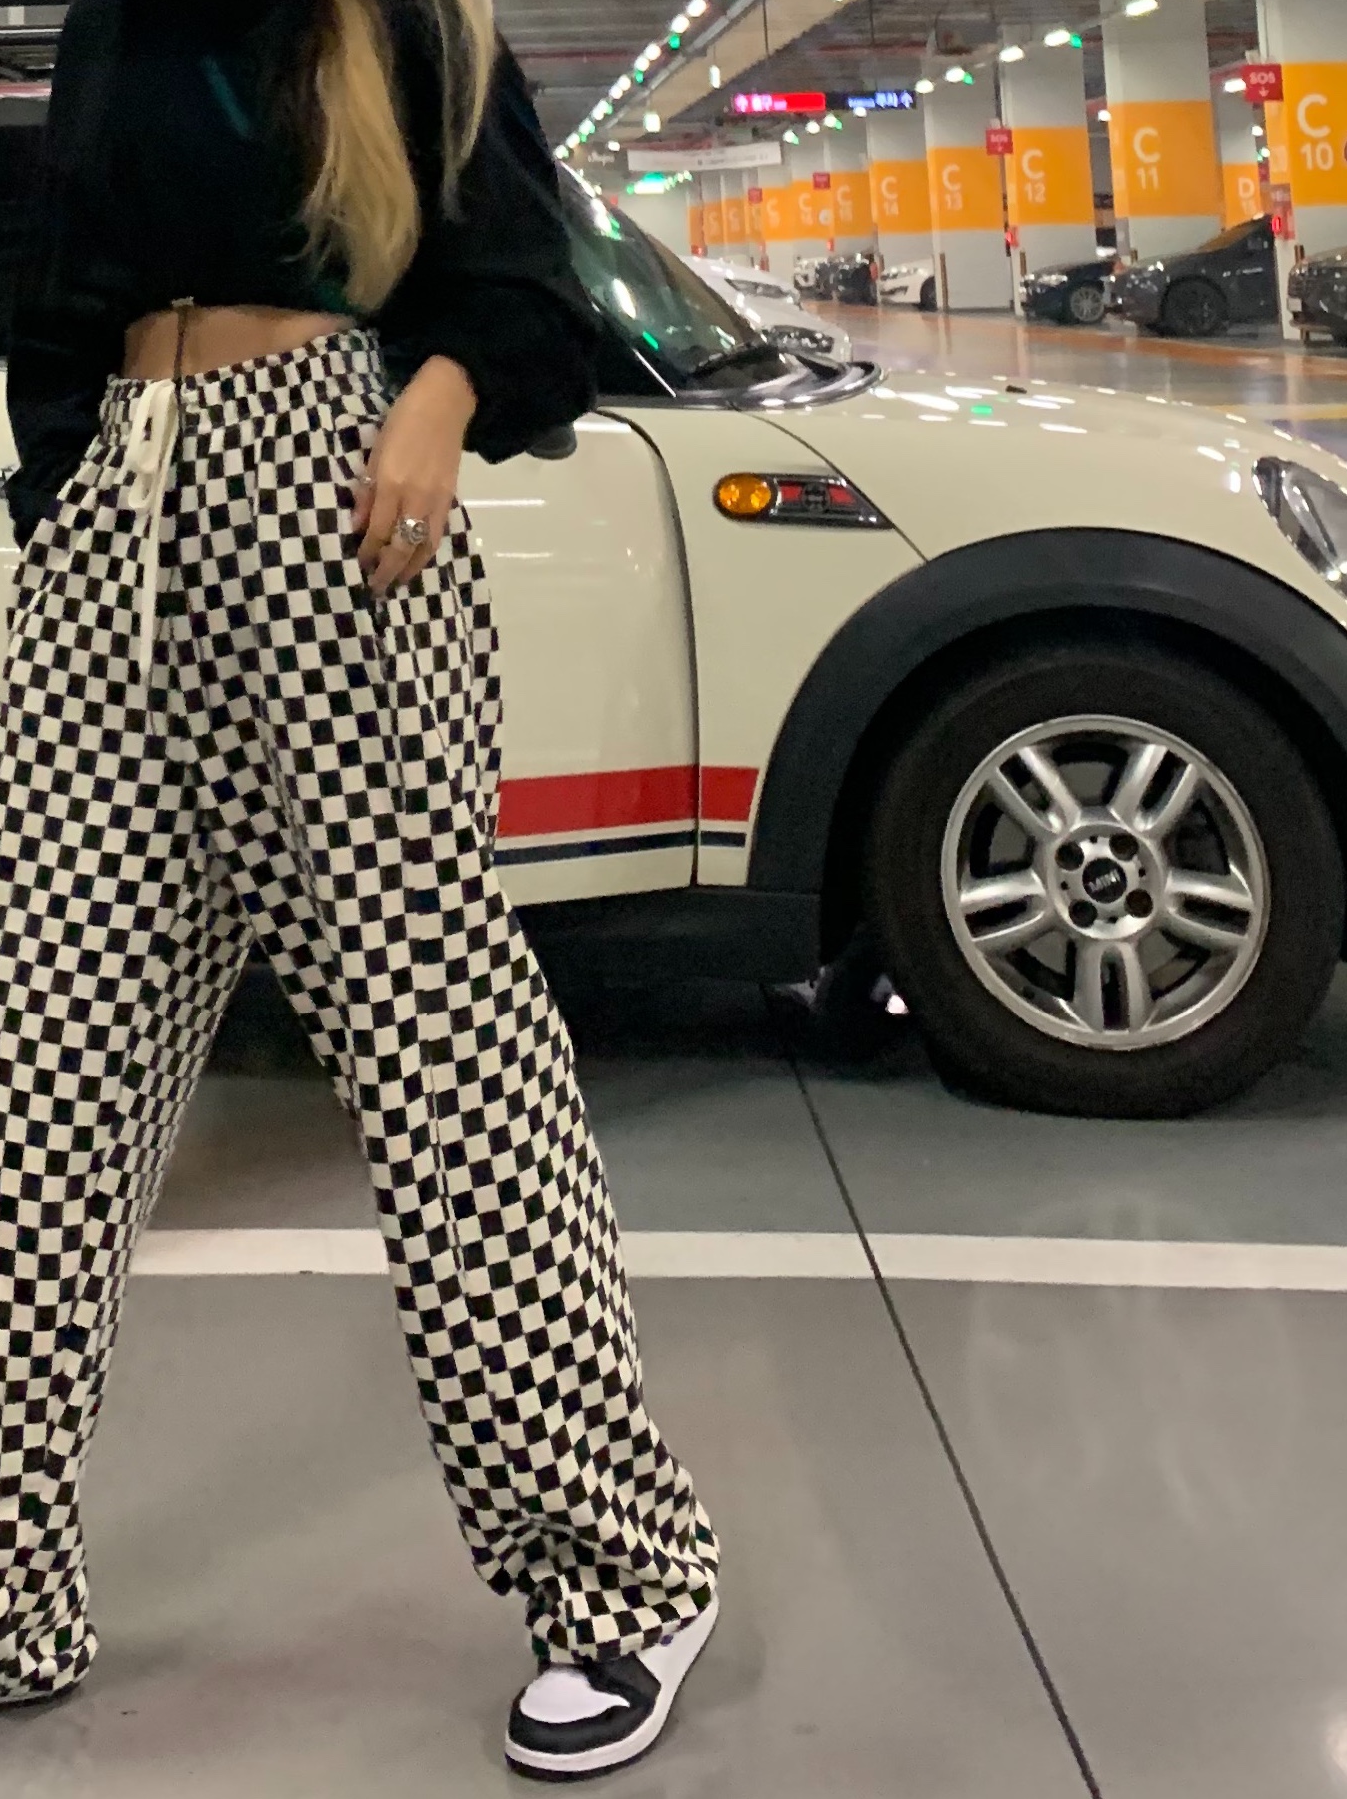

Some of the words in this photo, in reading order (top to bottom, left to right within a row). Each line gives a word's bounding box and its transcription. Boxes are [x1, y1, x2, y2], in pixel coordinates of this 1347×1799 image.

[1249, 71, 1276, 84] SOS
[1297, 93, 1331, 137] C
[1133, 127, 1161, 164] C
[1300, 142, 1334, 171] 10
[942, 163, 962, 191] C
[1021, 148, 1046, 179] C
[880, 175, 899, 200] C
[1136, 167, 1160, 191] 11
[1238, 177, 1255, 199] D
